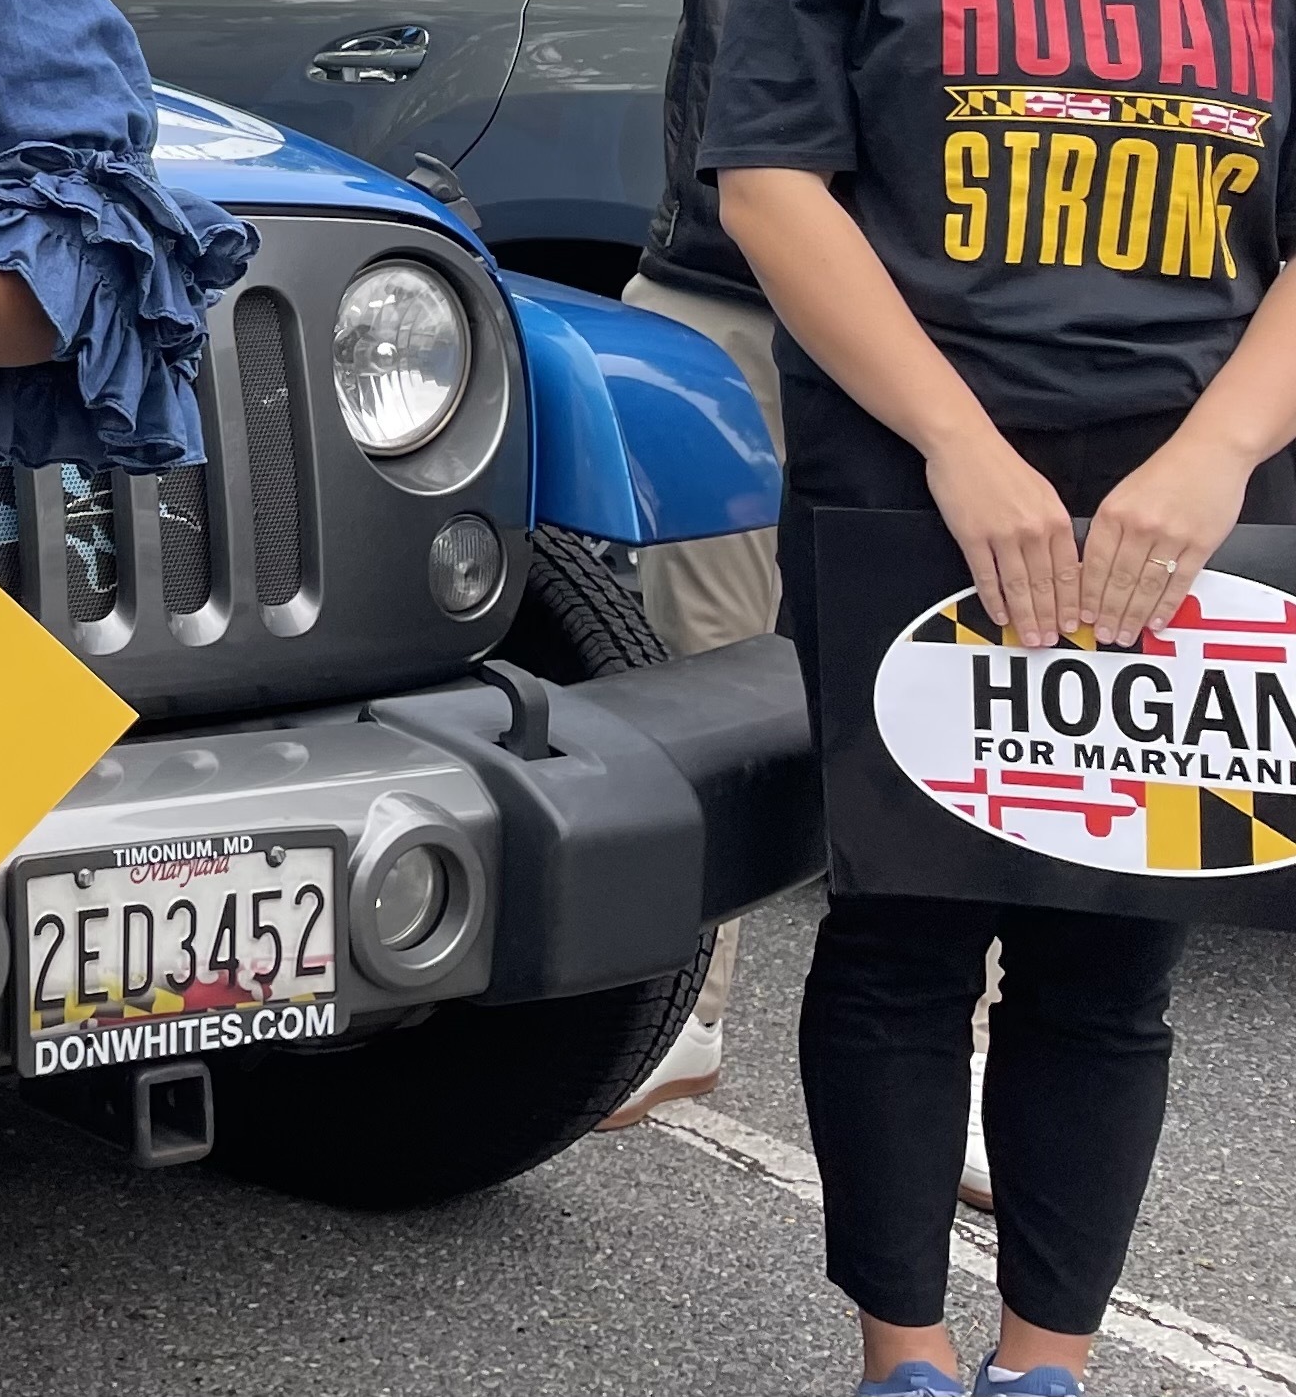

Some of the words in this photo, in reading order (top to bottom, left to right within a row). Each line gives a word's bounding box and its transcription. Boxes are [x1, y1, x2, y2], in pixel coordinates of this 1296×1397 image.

[944, 131, 1260, 280] STRONG
[972, 654, 1296, 752] HOGAN
[974, 737, 1054, 766] FOR
[1074, 743, 1296, 786] MARYLAN
[113, 839, 218, 867] TIMONIUM,
[223, 835, 253, 854] MD
[130, 855, 230, 888] Maryland
[33, 883, 327, 1012] 2ED3452
[34, 1002, 336, 1076] DONWHITES.COM
